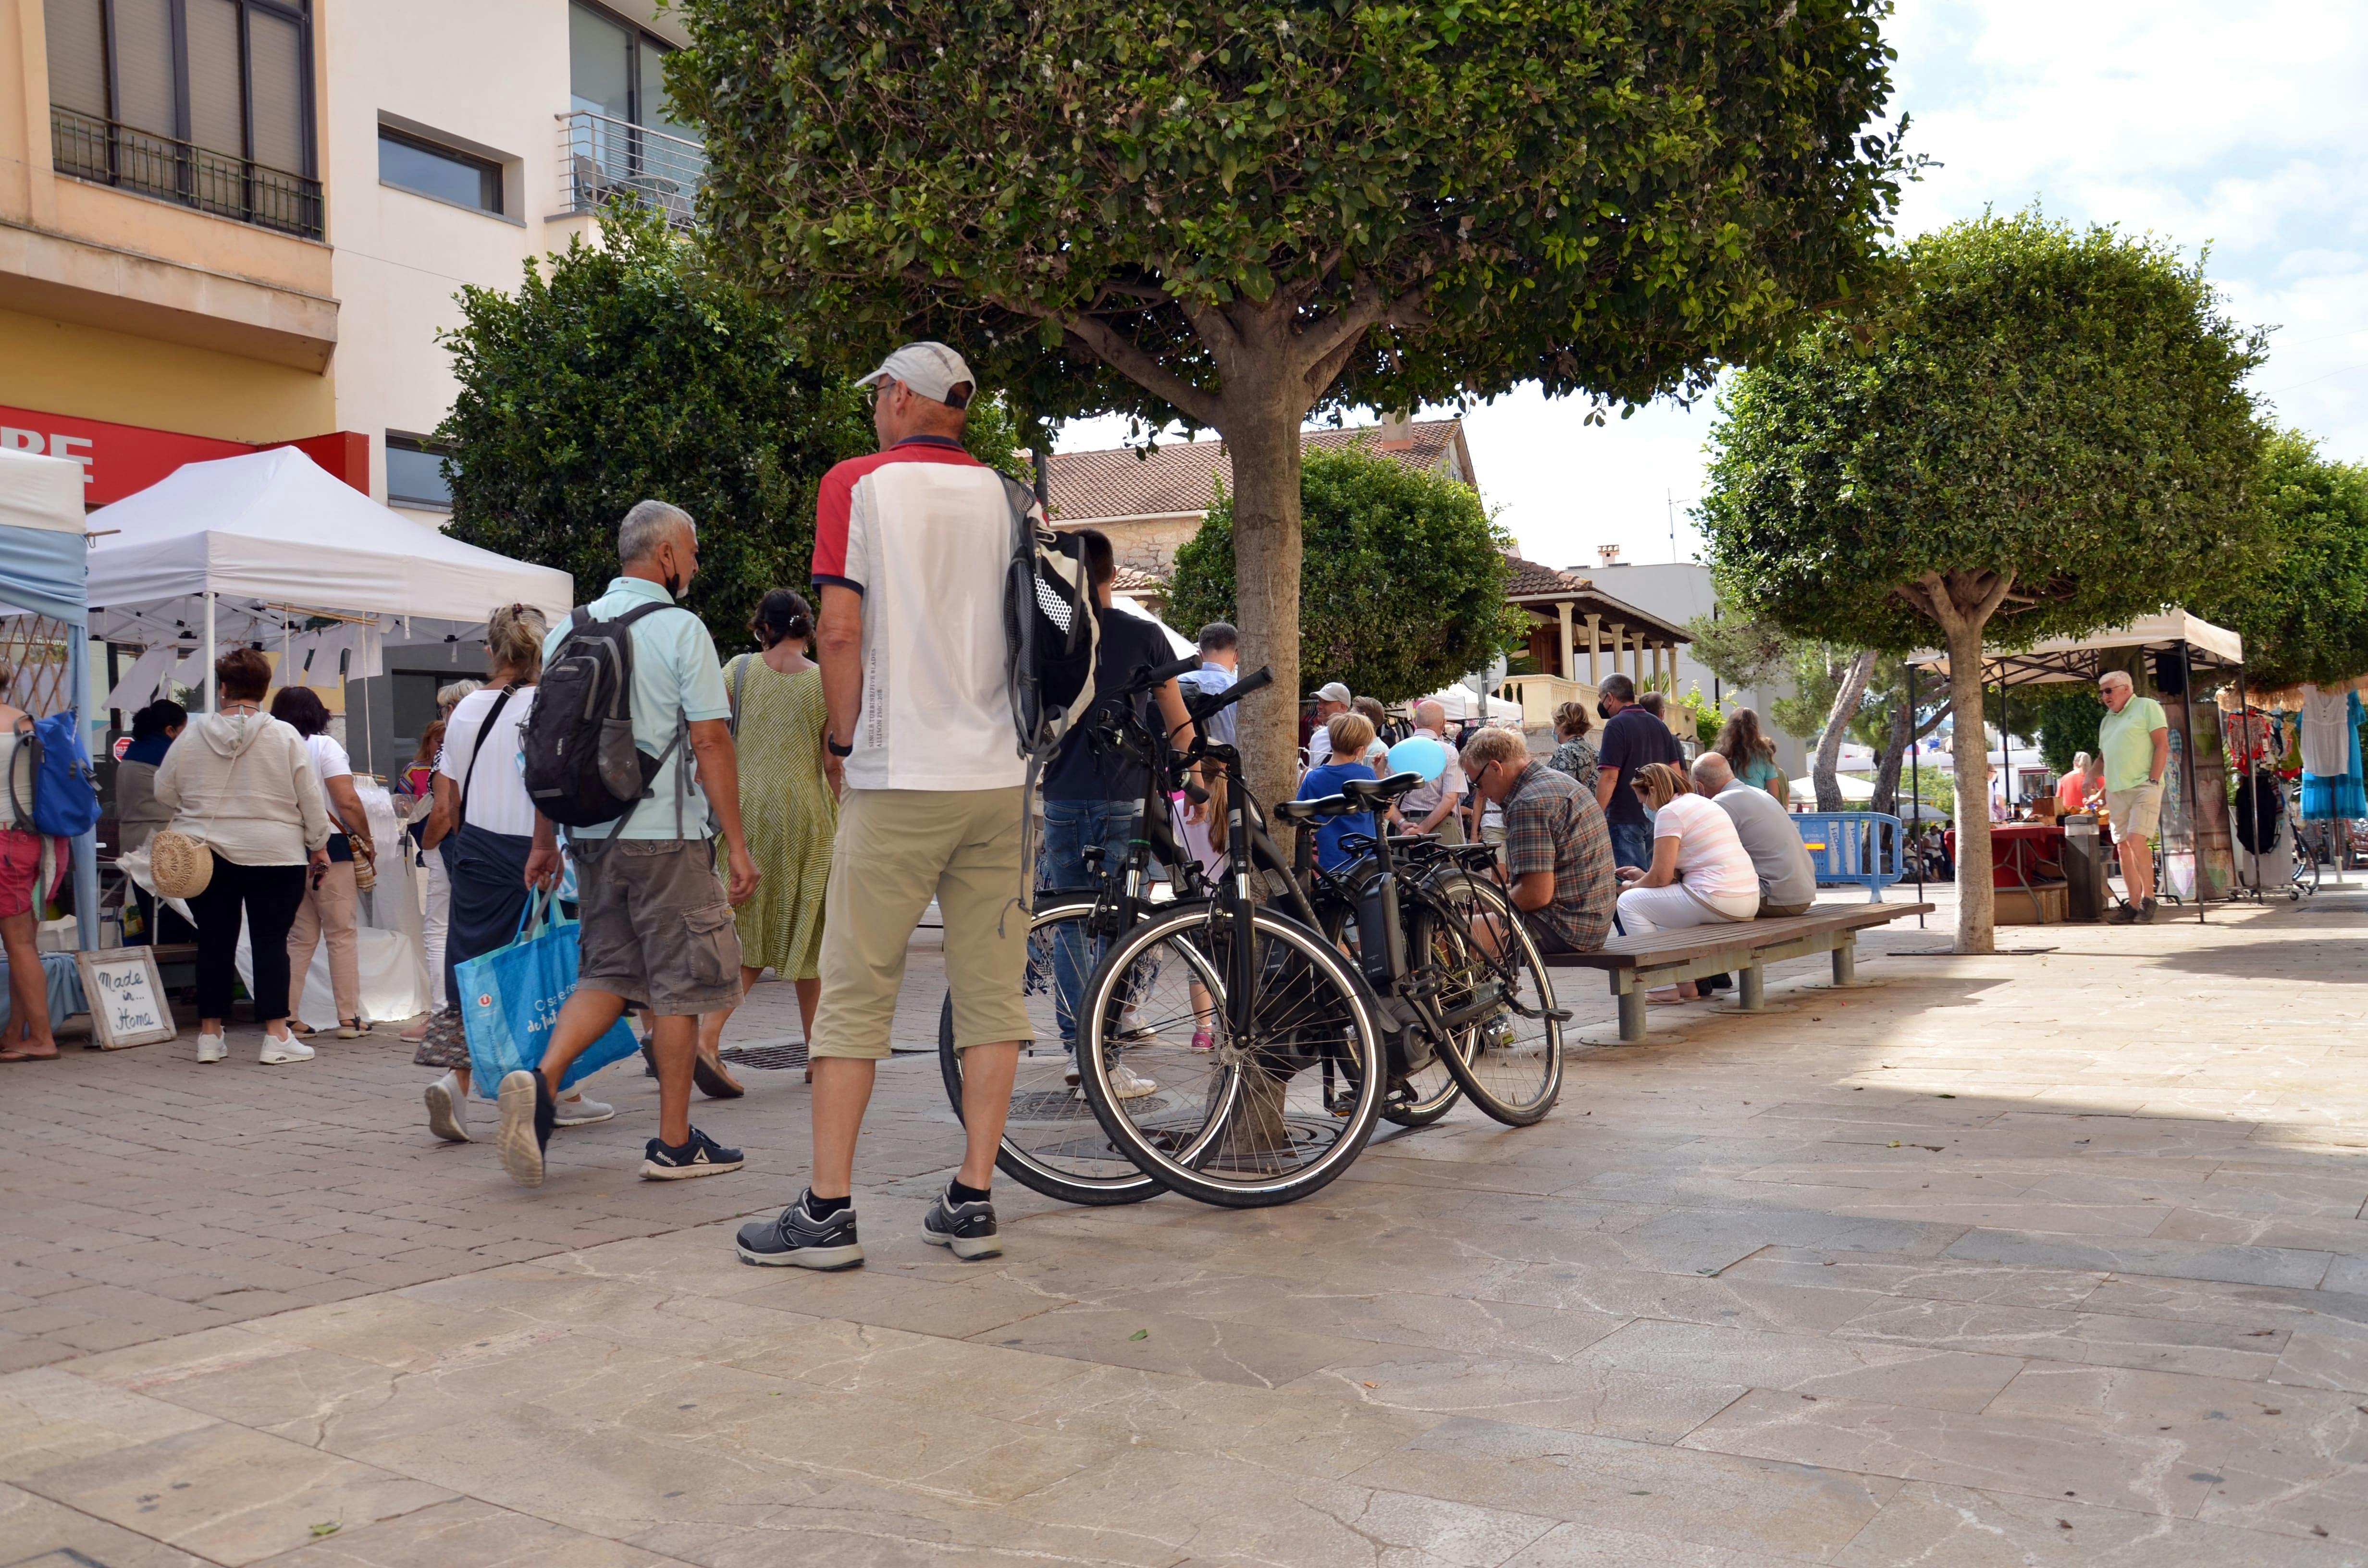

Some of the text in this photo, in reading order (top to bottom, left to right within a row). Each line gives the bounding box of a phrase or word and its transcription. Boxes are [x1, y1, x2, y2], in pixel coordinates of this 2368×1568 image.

[98, 969, 143, 992] Made
[116, 1007, 154, 1030] Home
[527, 1019, 542, 1032] de
[656, 1151, 678, 1167] Reebok
